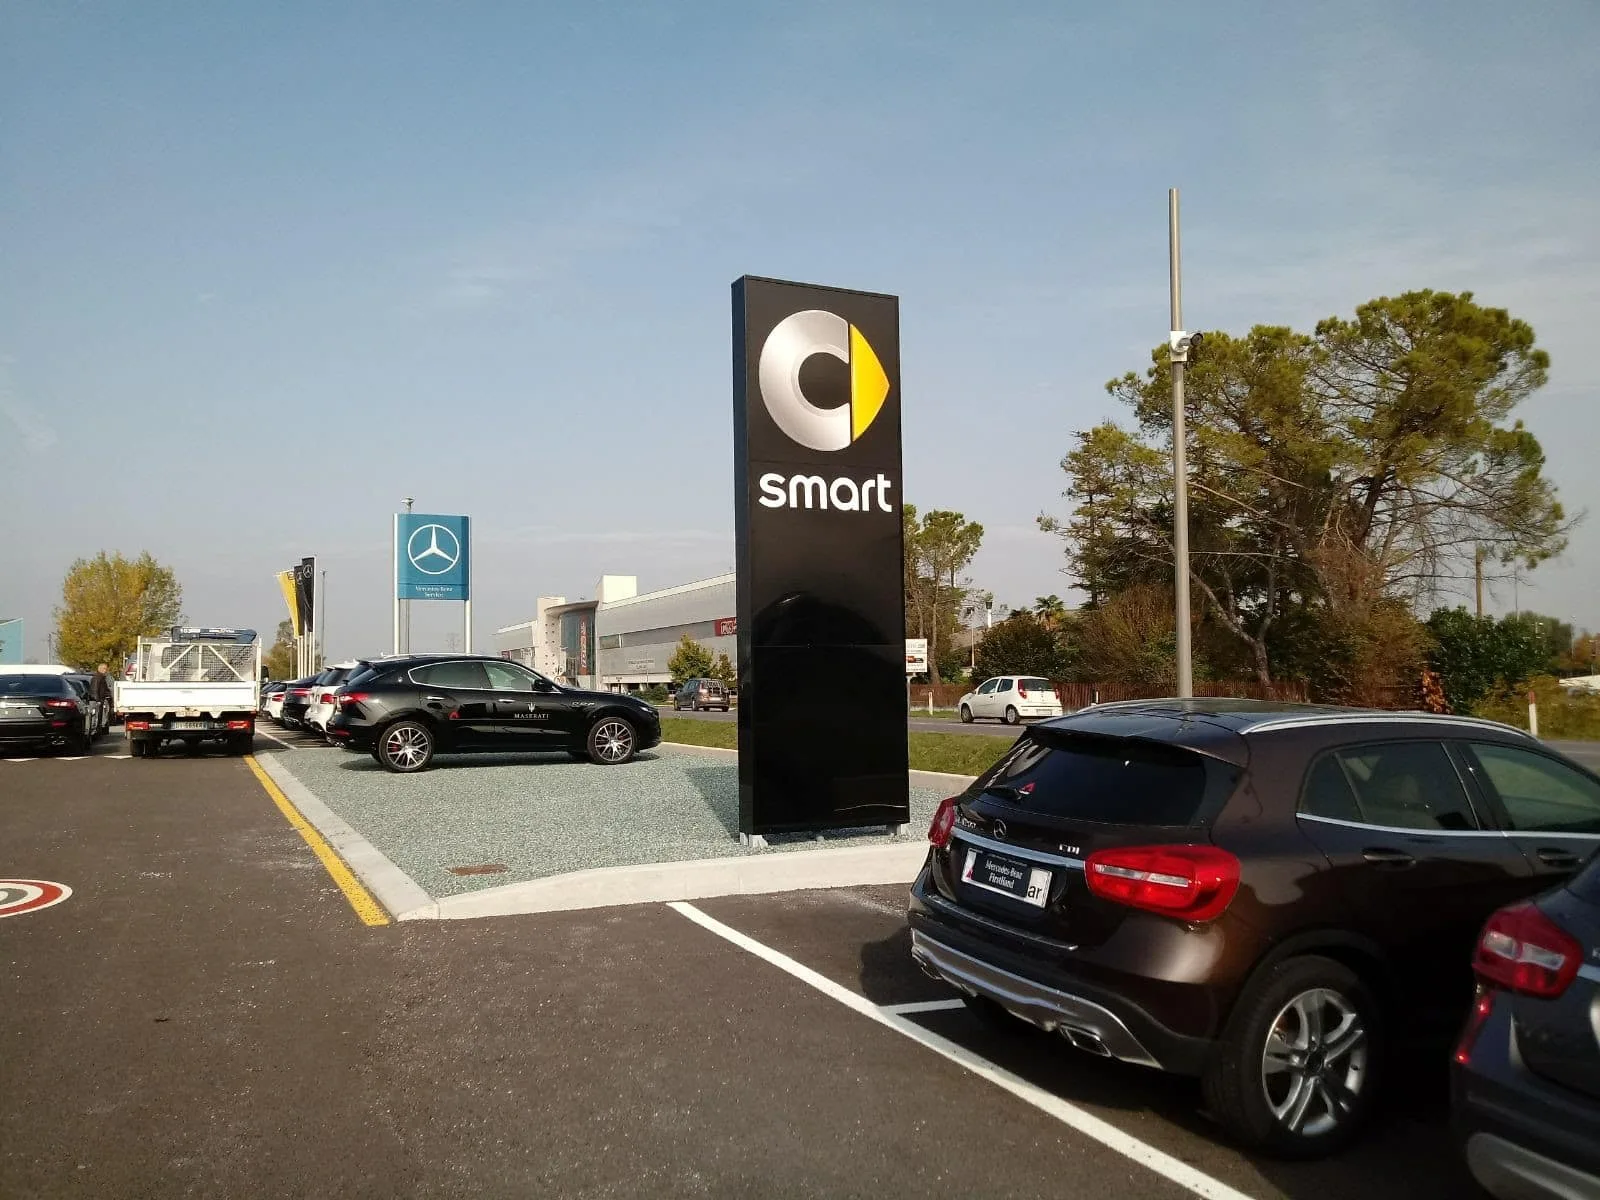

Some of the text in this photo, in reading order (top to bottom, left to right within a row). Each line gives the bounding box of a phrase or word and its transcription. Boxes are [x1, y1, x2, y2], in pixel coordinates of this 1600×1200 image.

[758, 472, 893, 513] smart
[985, 859, 1023, 880] Mercedes-Benz
[1027, 885, 1043, 900] ar
